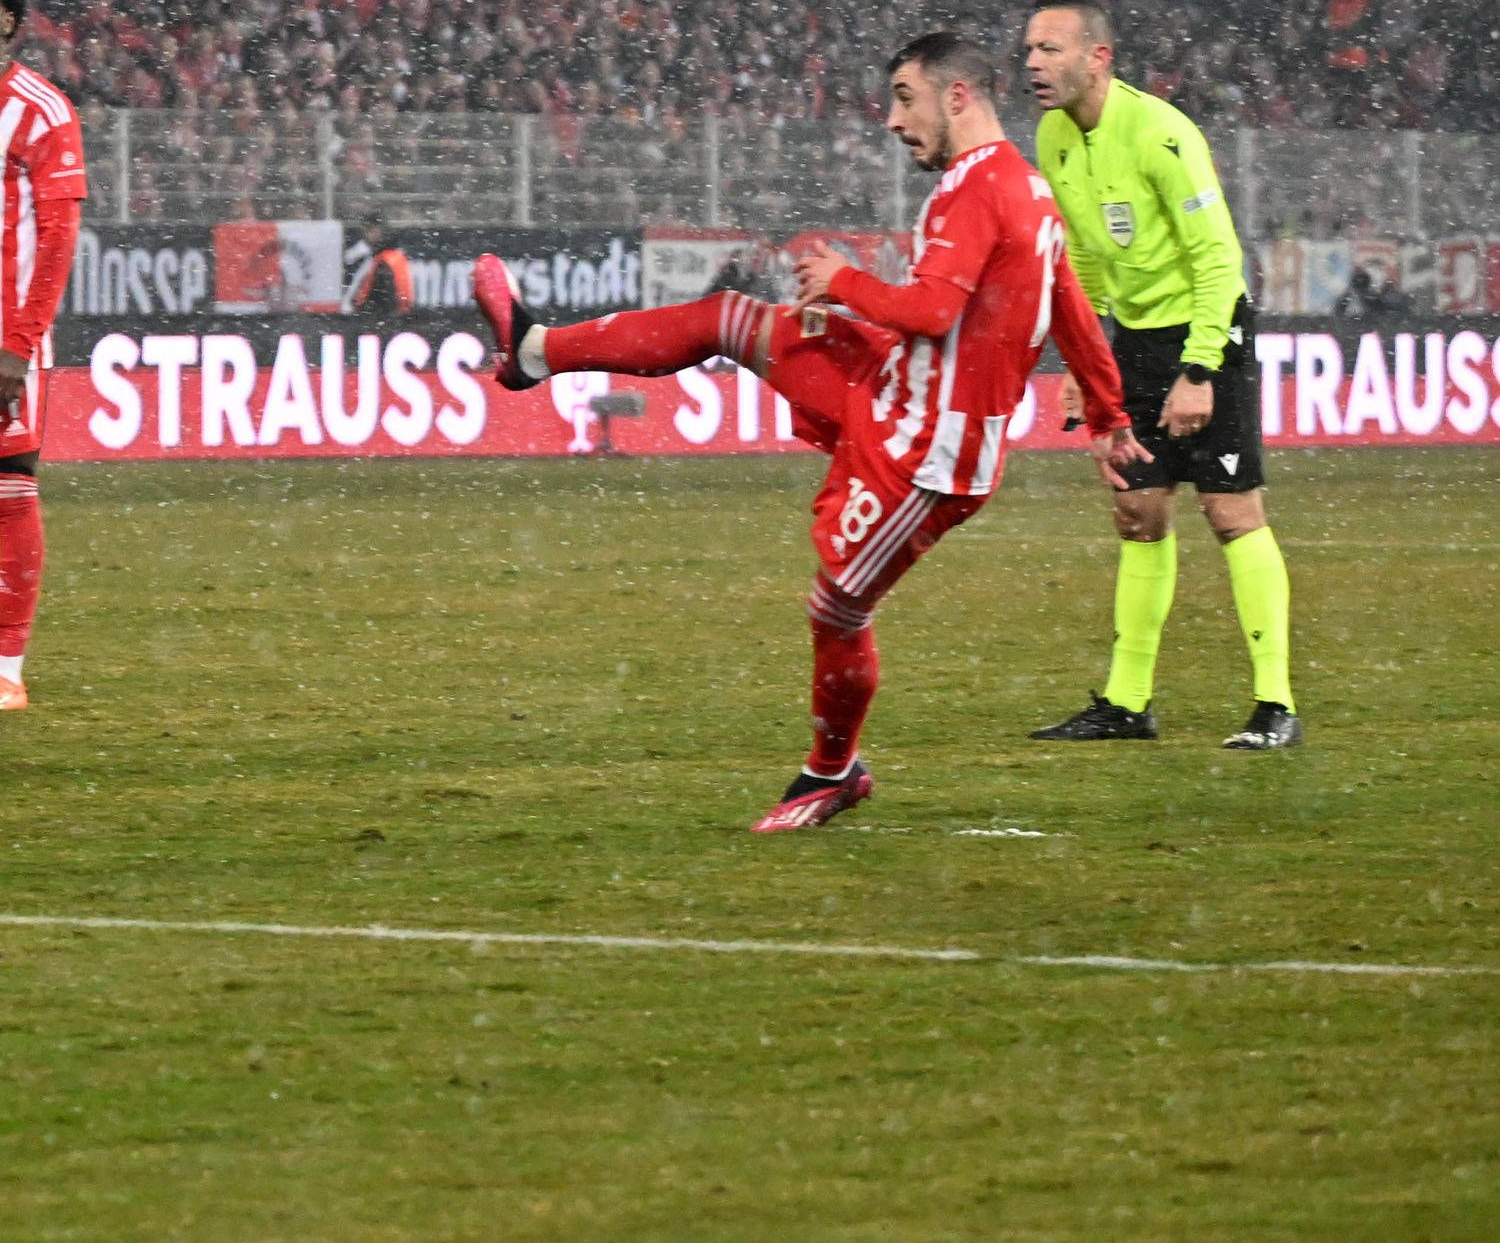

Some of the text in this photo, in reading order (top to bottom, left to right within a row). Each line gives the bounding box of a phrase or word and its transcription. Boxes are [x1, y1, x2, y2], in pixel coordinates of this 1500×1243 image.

[89, 332, 486, 448] STRAUSS
[1254, 331, 1500, 435] TRAUS
[838, 476, 883, 544] 18
